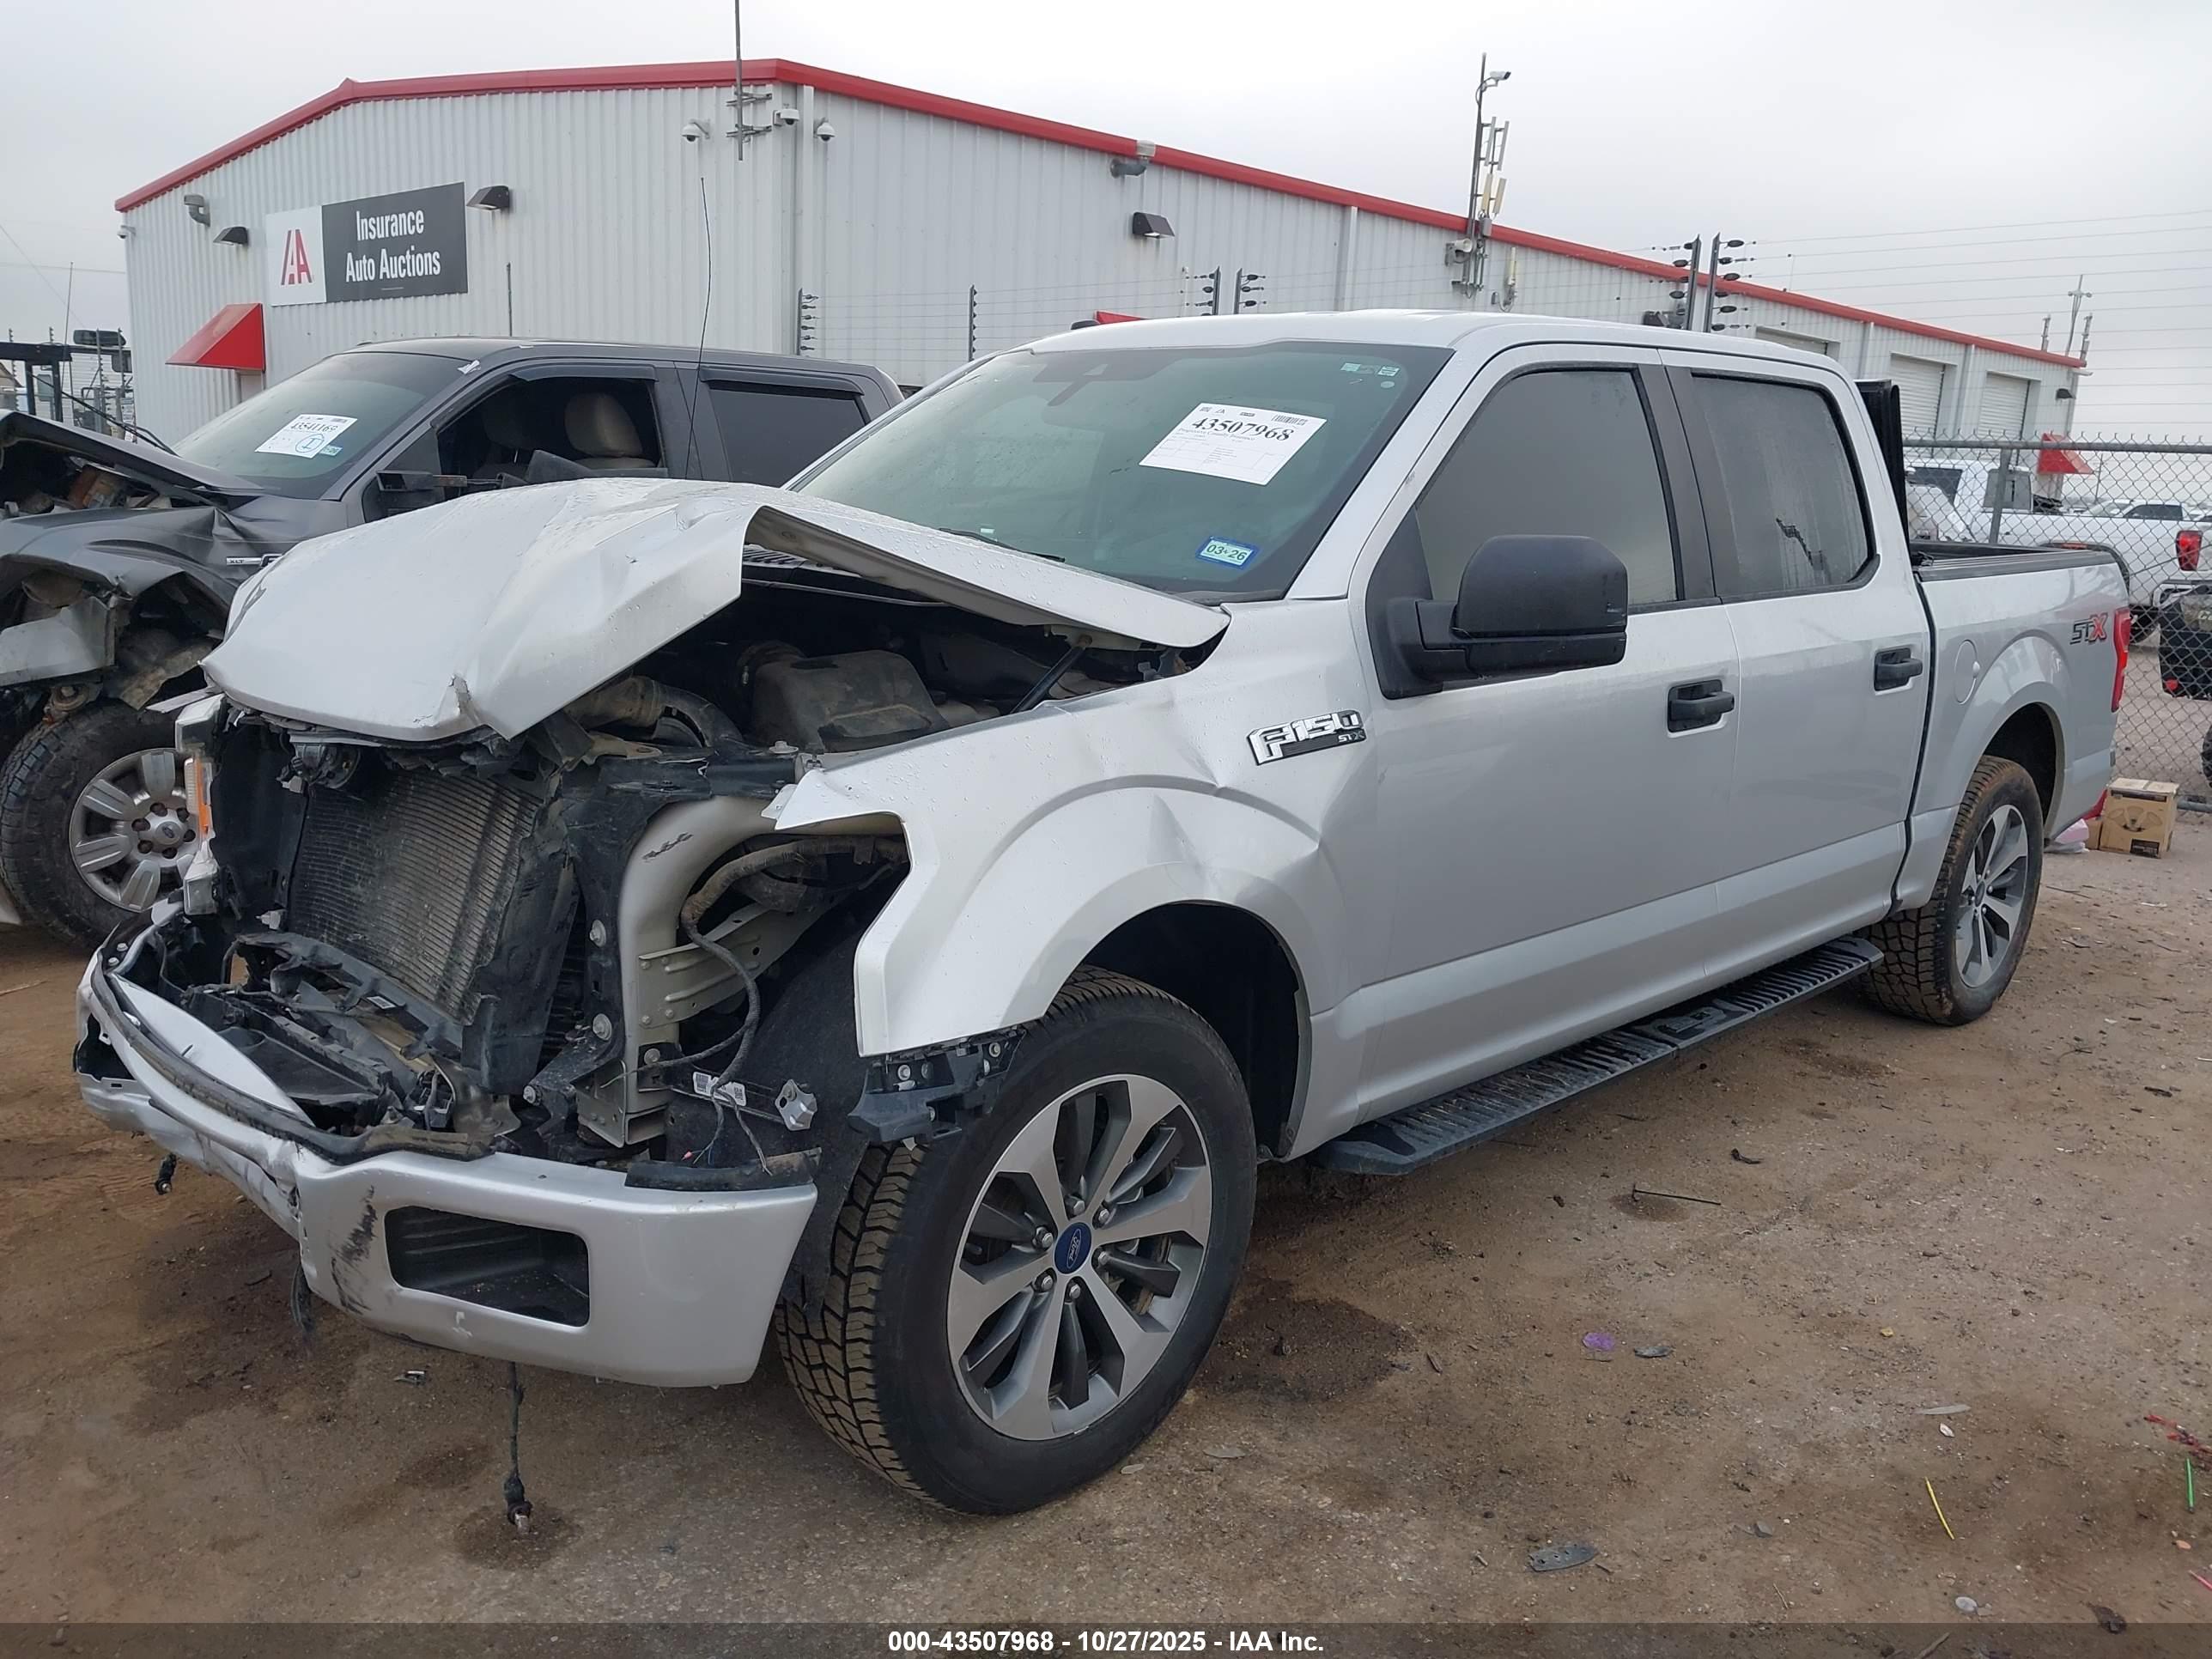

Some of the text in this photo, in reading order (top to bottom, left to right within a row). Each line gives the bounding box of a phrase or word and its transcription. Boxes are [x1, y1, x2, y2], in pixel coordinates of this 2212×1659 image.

[356, 209, 425, 241] Insurance
[345, 245, 441, 283] Auto Auctions
[1191, 416, 1295, 441] 43507968
[1206, 544, 1248, 561] 03 26
[2069, 612, 2109, 645] STX
[1338, 732, 1364, 743] STX
